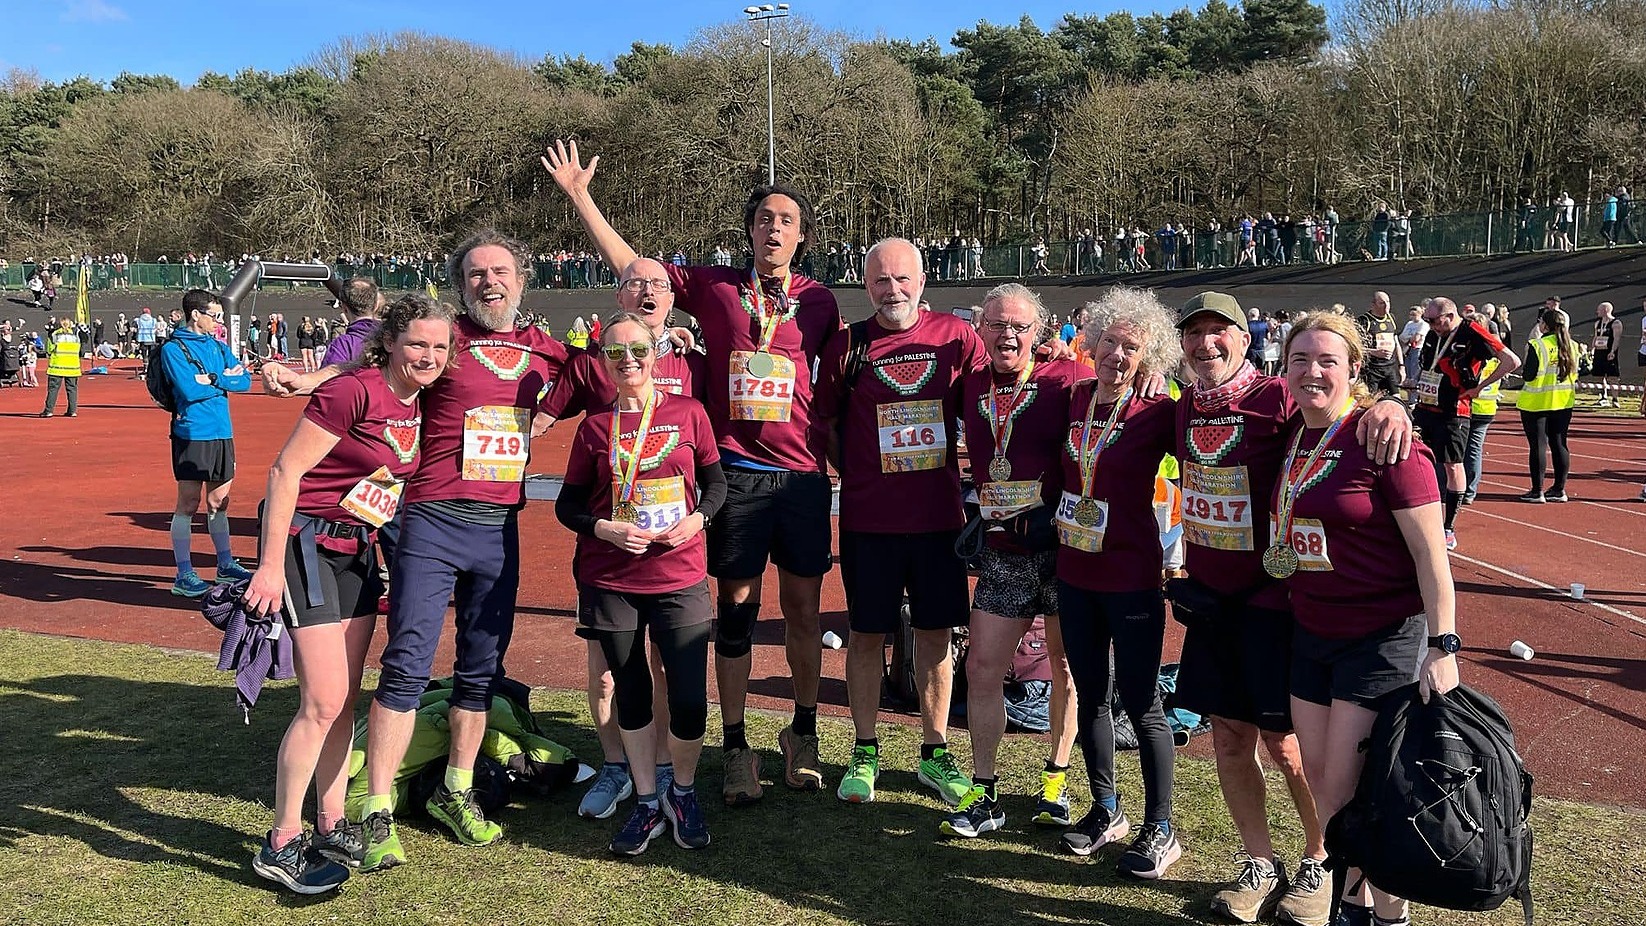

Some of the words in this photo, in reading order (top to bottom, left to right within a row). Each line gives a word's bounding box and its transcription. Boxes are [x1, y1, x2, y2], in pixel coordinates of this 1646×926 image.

[872, 357, 894, 366] running
[895, 355, 903, 363] for
[904, 352, 936, 361] PALESTINE
[734, 378, 790, 398] 1781
[477, 435, 521, 456] 719
[891, 428, 935, 448] 116
[1185, 496, 1247, 522] 1917
